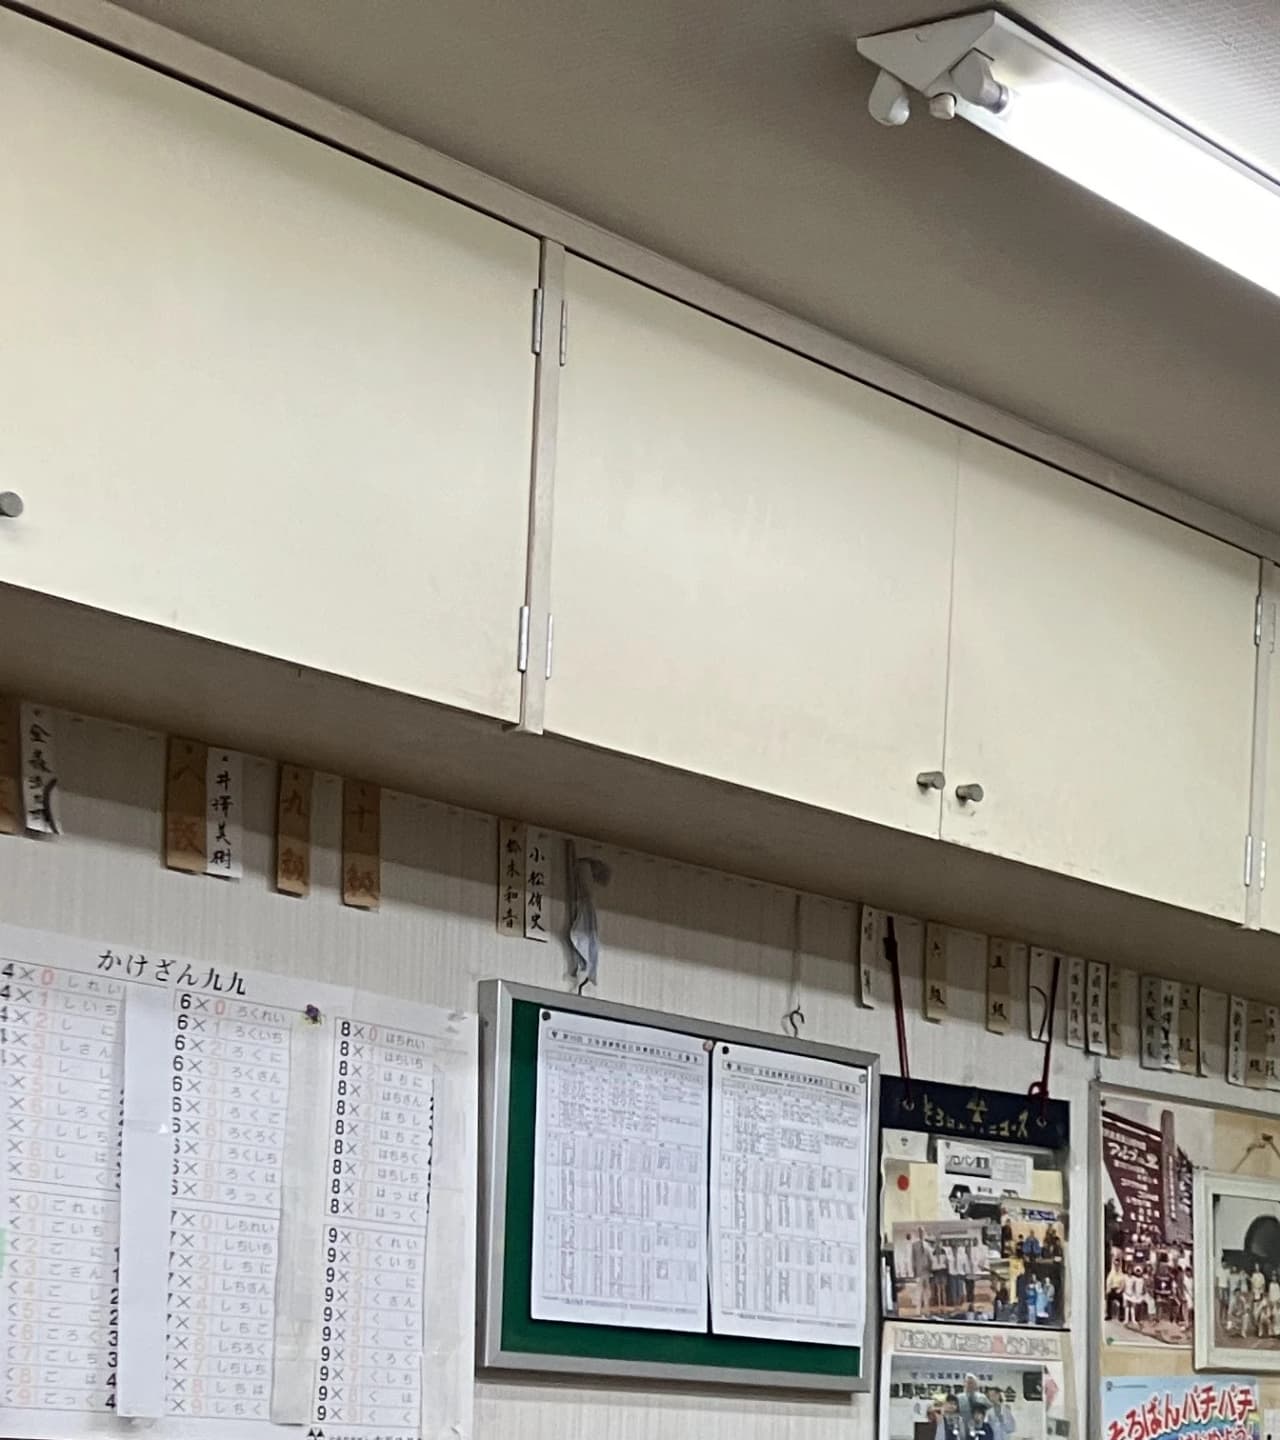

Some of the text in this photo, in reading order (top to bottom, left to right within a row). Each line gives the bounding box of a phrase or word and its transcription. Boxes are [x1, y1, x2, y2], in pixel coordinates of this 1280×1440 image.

[98, 949, 246, 995] かけざん九九
